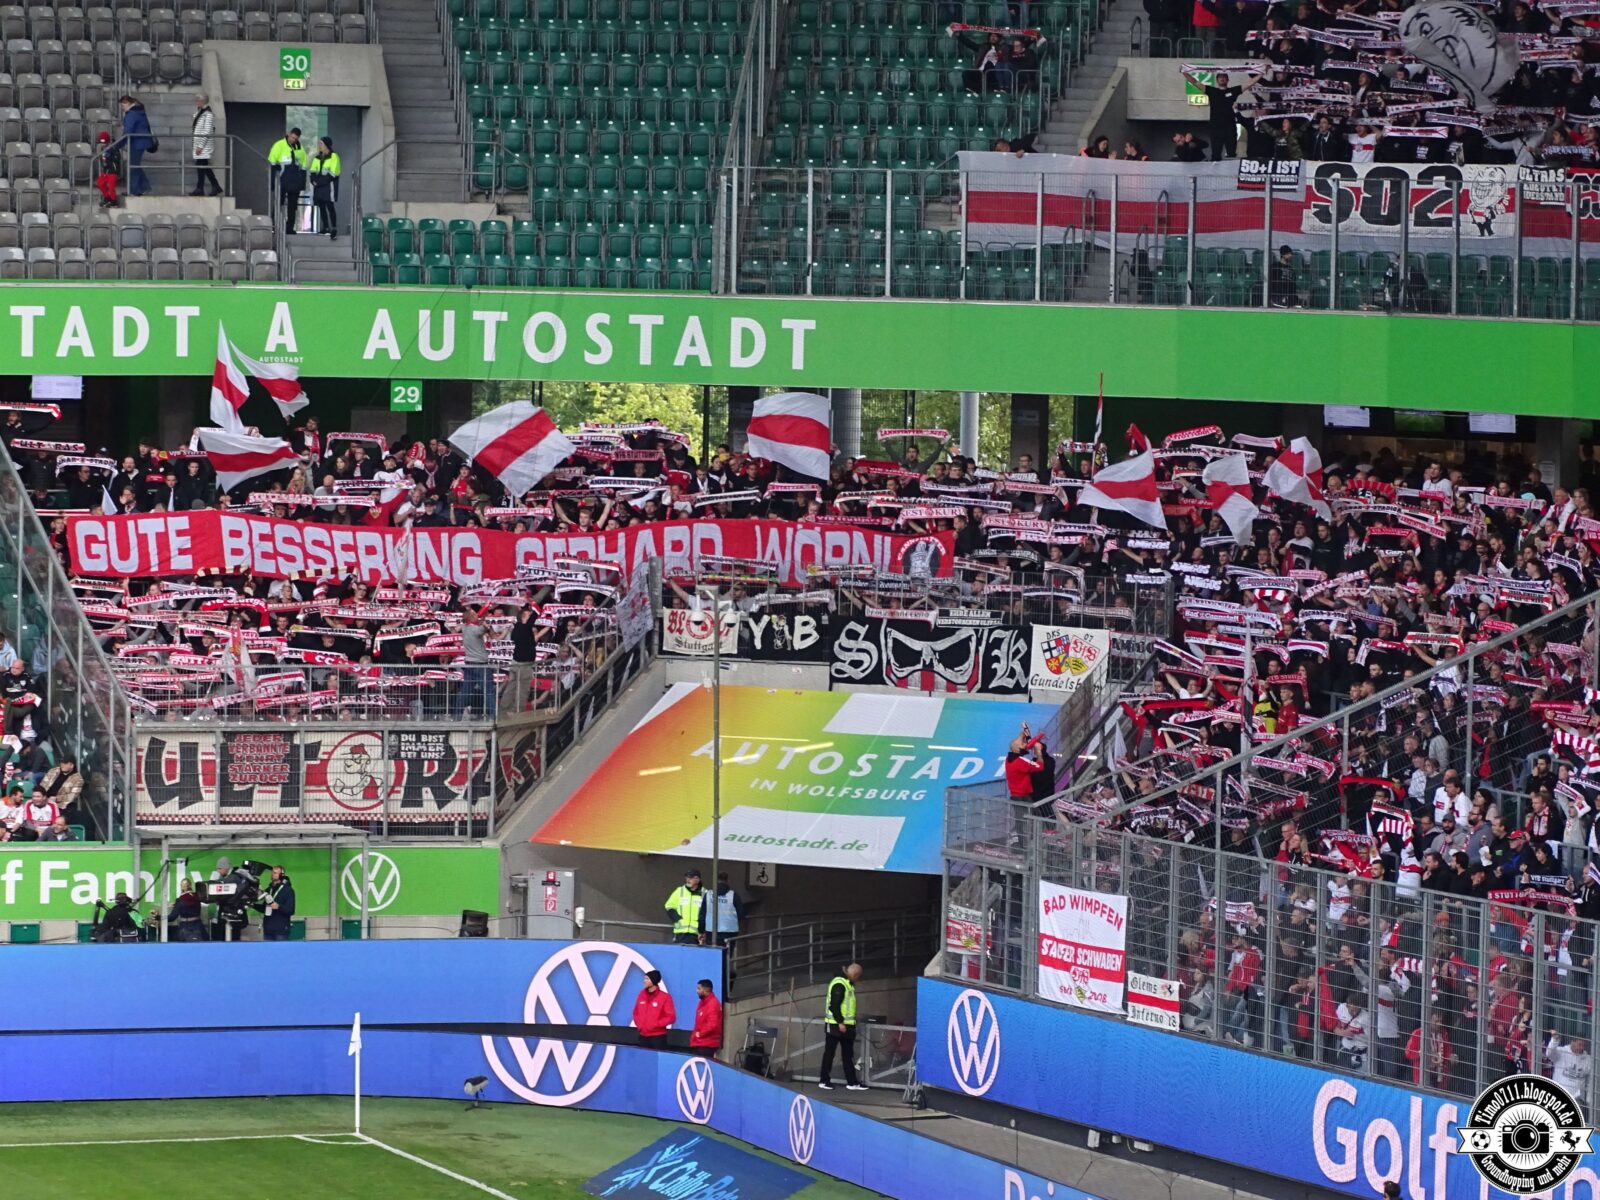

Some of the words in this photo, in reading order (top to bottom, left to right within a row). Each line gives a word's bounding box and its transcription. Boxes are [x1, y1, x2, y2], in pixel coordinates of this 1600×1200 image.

[282, 56, 308, 71] 30
[1276, 160, 1299, 174] IST
[362, 308, 817, 370] AUTOSTADT
[393, 386, 420, 403] 29
[75, 516, 193, 573] GUTE
[220, 515, 483, 588] BESSERUNG
[178, 588, 230, 597] STUTTGART
[748, 615, 771, 650] Y
[792, 615, 820, 650] B
[674, 636, 724, 653] Stuttgat
[831, 621, 879, 680] S
[235, 734, 283, 744] JEDER
[400, 734, 417, 743] DU
[421, 734, 446, 743] BIST
[400, 743, 446, 752] IMMER
[228, 743, 290, 754] VERBANNTE
[400, 751, 419, 760] BEI
[690, 737, 1006, 781] AUTOSTADT
[749, 778, 777, 792] IN
[787, 782, 928, 801] WOLFSBURG
[723, 832, 869, 852] autostadt.de
[40, 858, 220, 904] Faml
[1043, 895, 1066, 915] BAD
[1070, 895, 1124, 932] WIMPFEN
[1077, 946, 1123, 972] SCHWABEN
[1131, 976, 1158, 994] Glems
[1312, 1079, 1458, 1200] Golf
